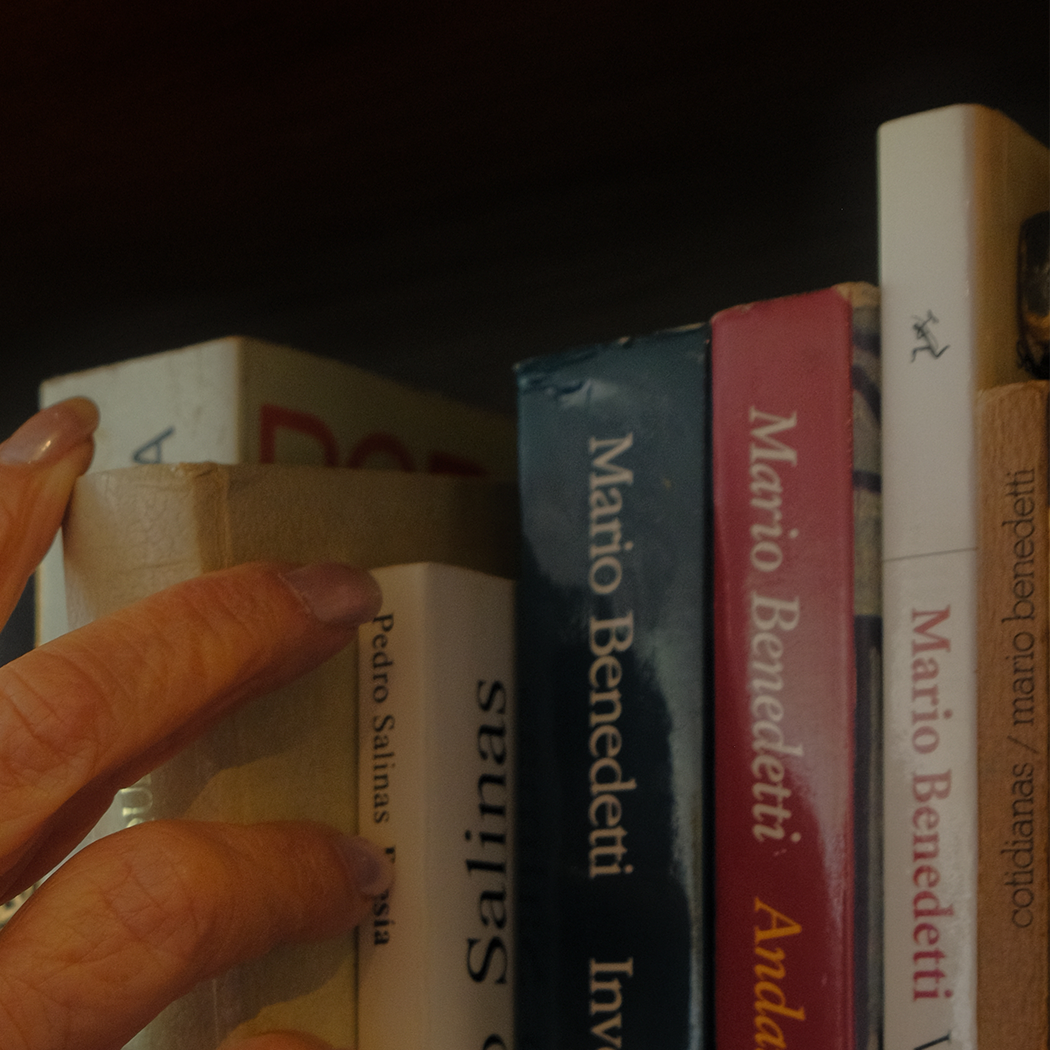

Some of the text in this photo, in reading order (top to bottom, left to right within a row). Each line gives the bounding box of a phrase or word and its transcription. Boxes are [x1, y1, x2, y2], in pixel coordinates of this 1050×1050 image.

[589, 432, 634, 596] Mario
[748, 406, 798, 573] Mario
[1001, 467, 1036, 624] benedetti
[371, 611, 395, 704] Pedro
[748, 589, 803, 845] Benedetti
[911, 604, 954, 756] Mario
[1005, 631, 1036, 726] mario
[372, 714, 396, 825] Salinas
[589, 609, 637, 880] Benedetti
[464, 679, 509, 987] Salinas
[912, 767, 955, 1002] Benedetti
[1000, 762, 1036, 929] cotidianas
